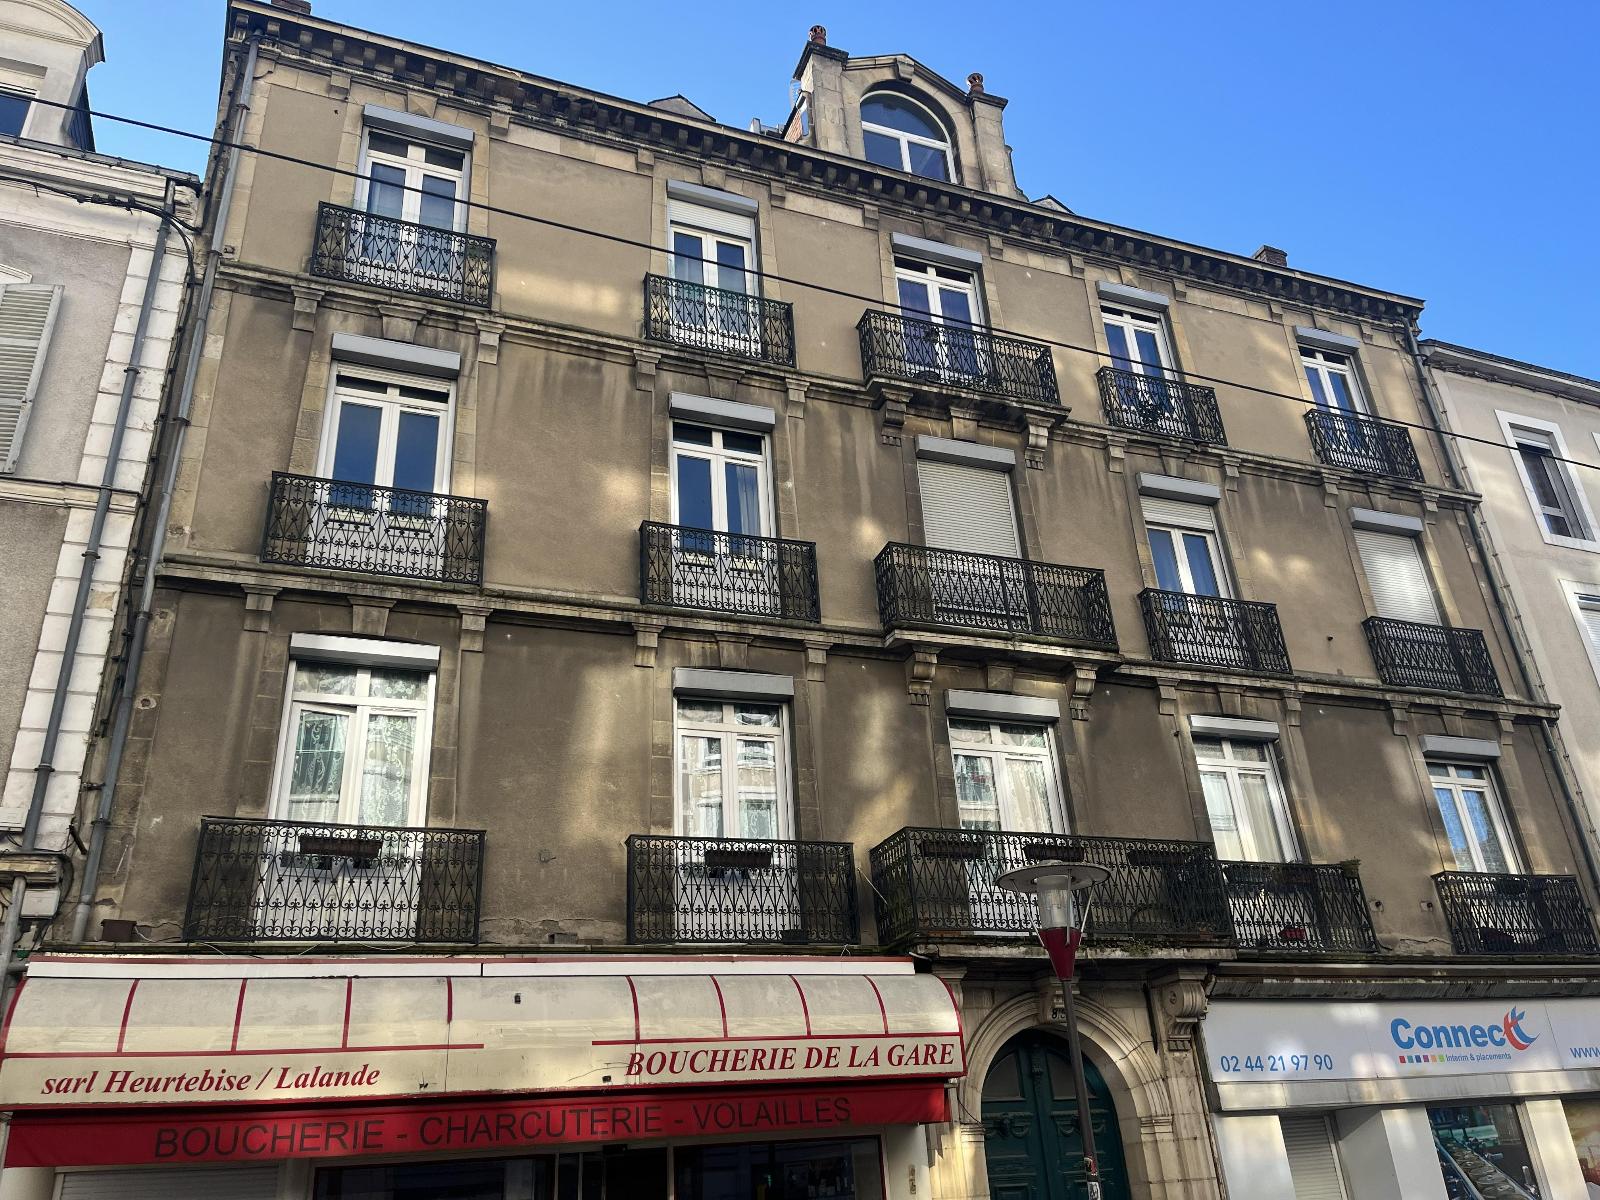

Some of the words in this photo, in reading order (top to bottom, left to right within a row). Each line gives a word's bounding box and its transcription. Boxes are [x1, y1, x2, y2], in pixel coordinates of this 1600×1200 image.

[626, 1047, 796, 1076] BOUCHERIE
[803, 1047, 840, 1069] DE
[847, 1045, 881, 1067] LA
[887, 1043, 955, 1066] GARE
[1220, 1055, 1241, 1072] 02
[1244, 1055, 1265, 1072] 44
[1267, 1055, 1286, 1072] 21
[1290, 1054, 1309, 1071] 97
[1313, 1054, 1333, 1071] 90
[1469, 1053, 1475, 1061] &
[1476, 1052, 1512, 1062] placements
[41, 1071, 97, 1095] sarl
[103, 1068, 252, 1094] Heurtebise
[255, 1067, 272, 1091] /
[273, 1064, 381, 1090] Lalande
[154, 1120, 384, 1158] BOUCHERIE
[420, 1106, 662, 1145] CHARCUTERIE
[693, 1098, 851, 1130] VOLAILLES
